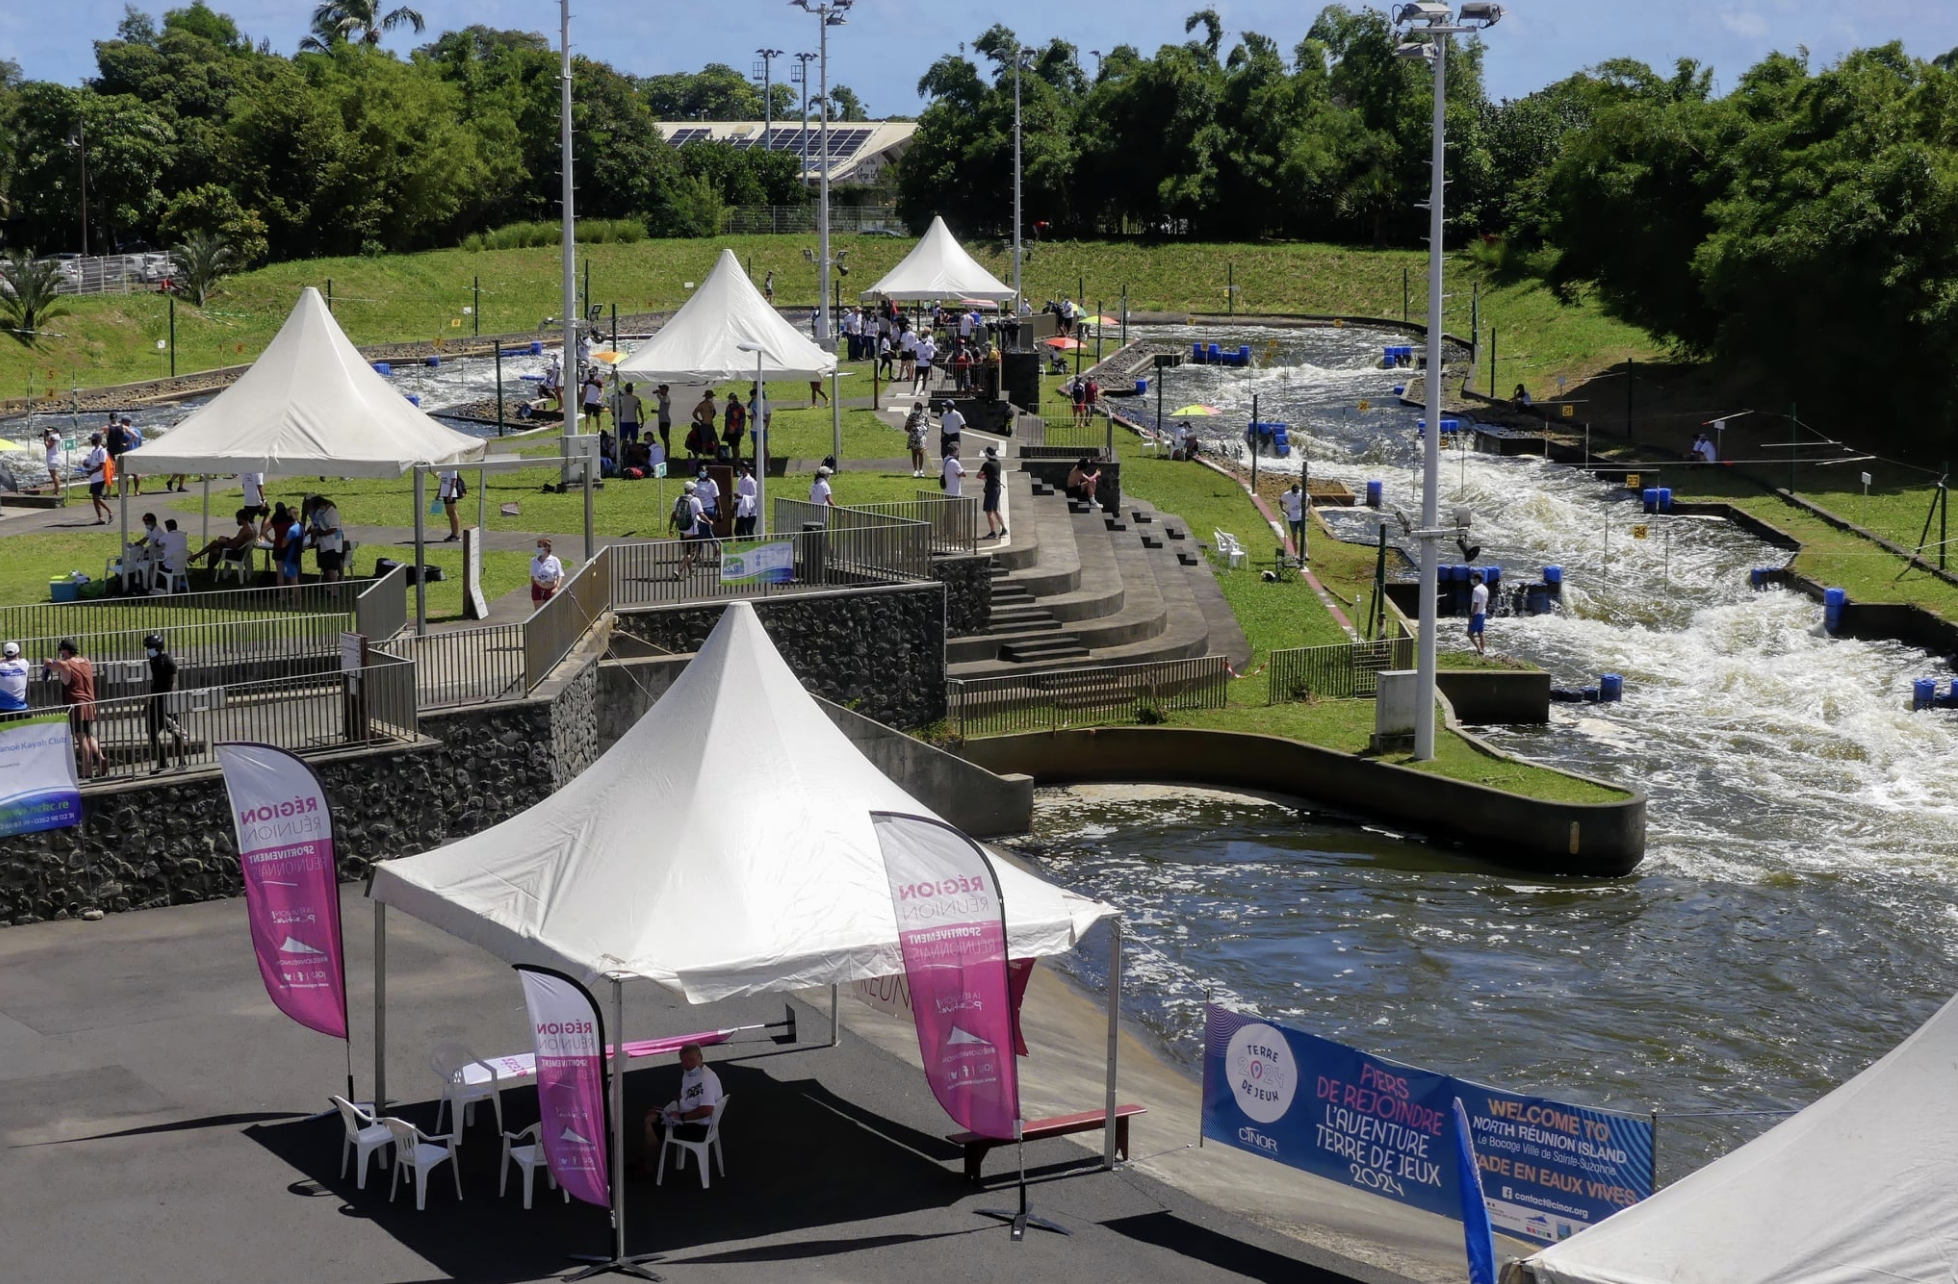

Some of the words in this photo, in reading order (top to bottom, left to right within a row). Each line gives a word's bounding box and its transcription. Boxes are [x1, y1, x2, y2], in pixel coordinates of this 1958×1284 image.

[1563, 406, 1572, 415] 21
[1633, 527, 1645, 538] 24
[1247, 1045, 1278, 1063] TERRE
[1238, 1056, 1285, 1088] 2024
[1360, 1063, 1410, 1099] FIERS
[1242, 1079, 1253, 1095] DE
[1254, 1087, 1279, 1101] JEUX
[1317, 1076, 1341, 1103] DE
[1344, 1084, 1445, 1136] REJOINDRE
[1326, 1104, 1430, 1158] L'AVENTURE
[1488, 1098, 1580, 1135] WELCOME
[1583, 1119, 1609, 1142] TO
[1239, 1127, 1278, 1152] CINOR
[1316, 1124, 1366, 1164] TERRE
[1371, 1146, 1395, 1173] DE
[1397, 1154, 1441, 1187] JEUX
[1472, 1115, 1515, 1137] NORTH
[1519, 1125, 1576, 1152] RÉUNION
[1578, 1141, 1627, 1164] ISLAND
[1477, 1133, 1487, 1145] Le
[1489, 1135, 1520, 1153] Bocage
[1522, 1142, 1539, 1157] Ville
[1541, 1148, 1551, 1160] de
[1553, 1151, 1616, 1176] Sainte-Suzanne
[1350, 1164, 1404, 1196] 2024
[1475, 1153, 1510, 1176] ADE
[1514, 1162, 1536, 1183] EN
[1540, 1168, 1583, 1195] EAUX
[1586, 1180, 1637, 1206] VIVES
[1514, 1191, 1589, 1220] contact@cinor.org
